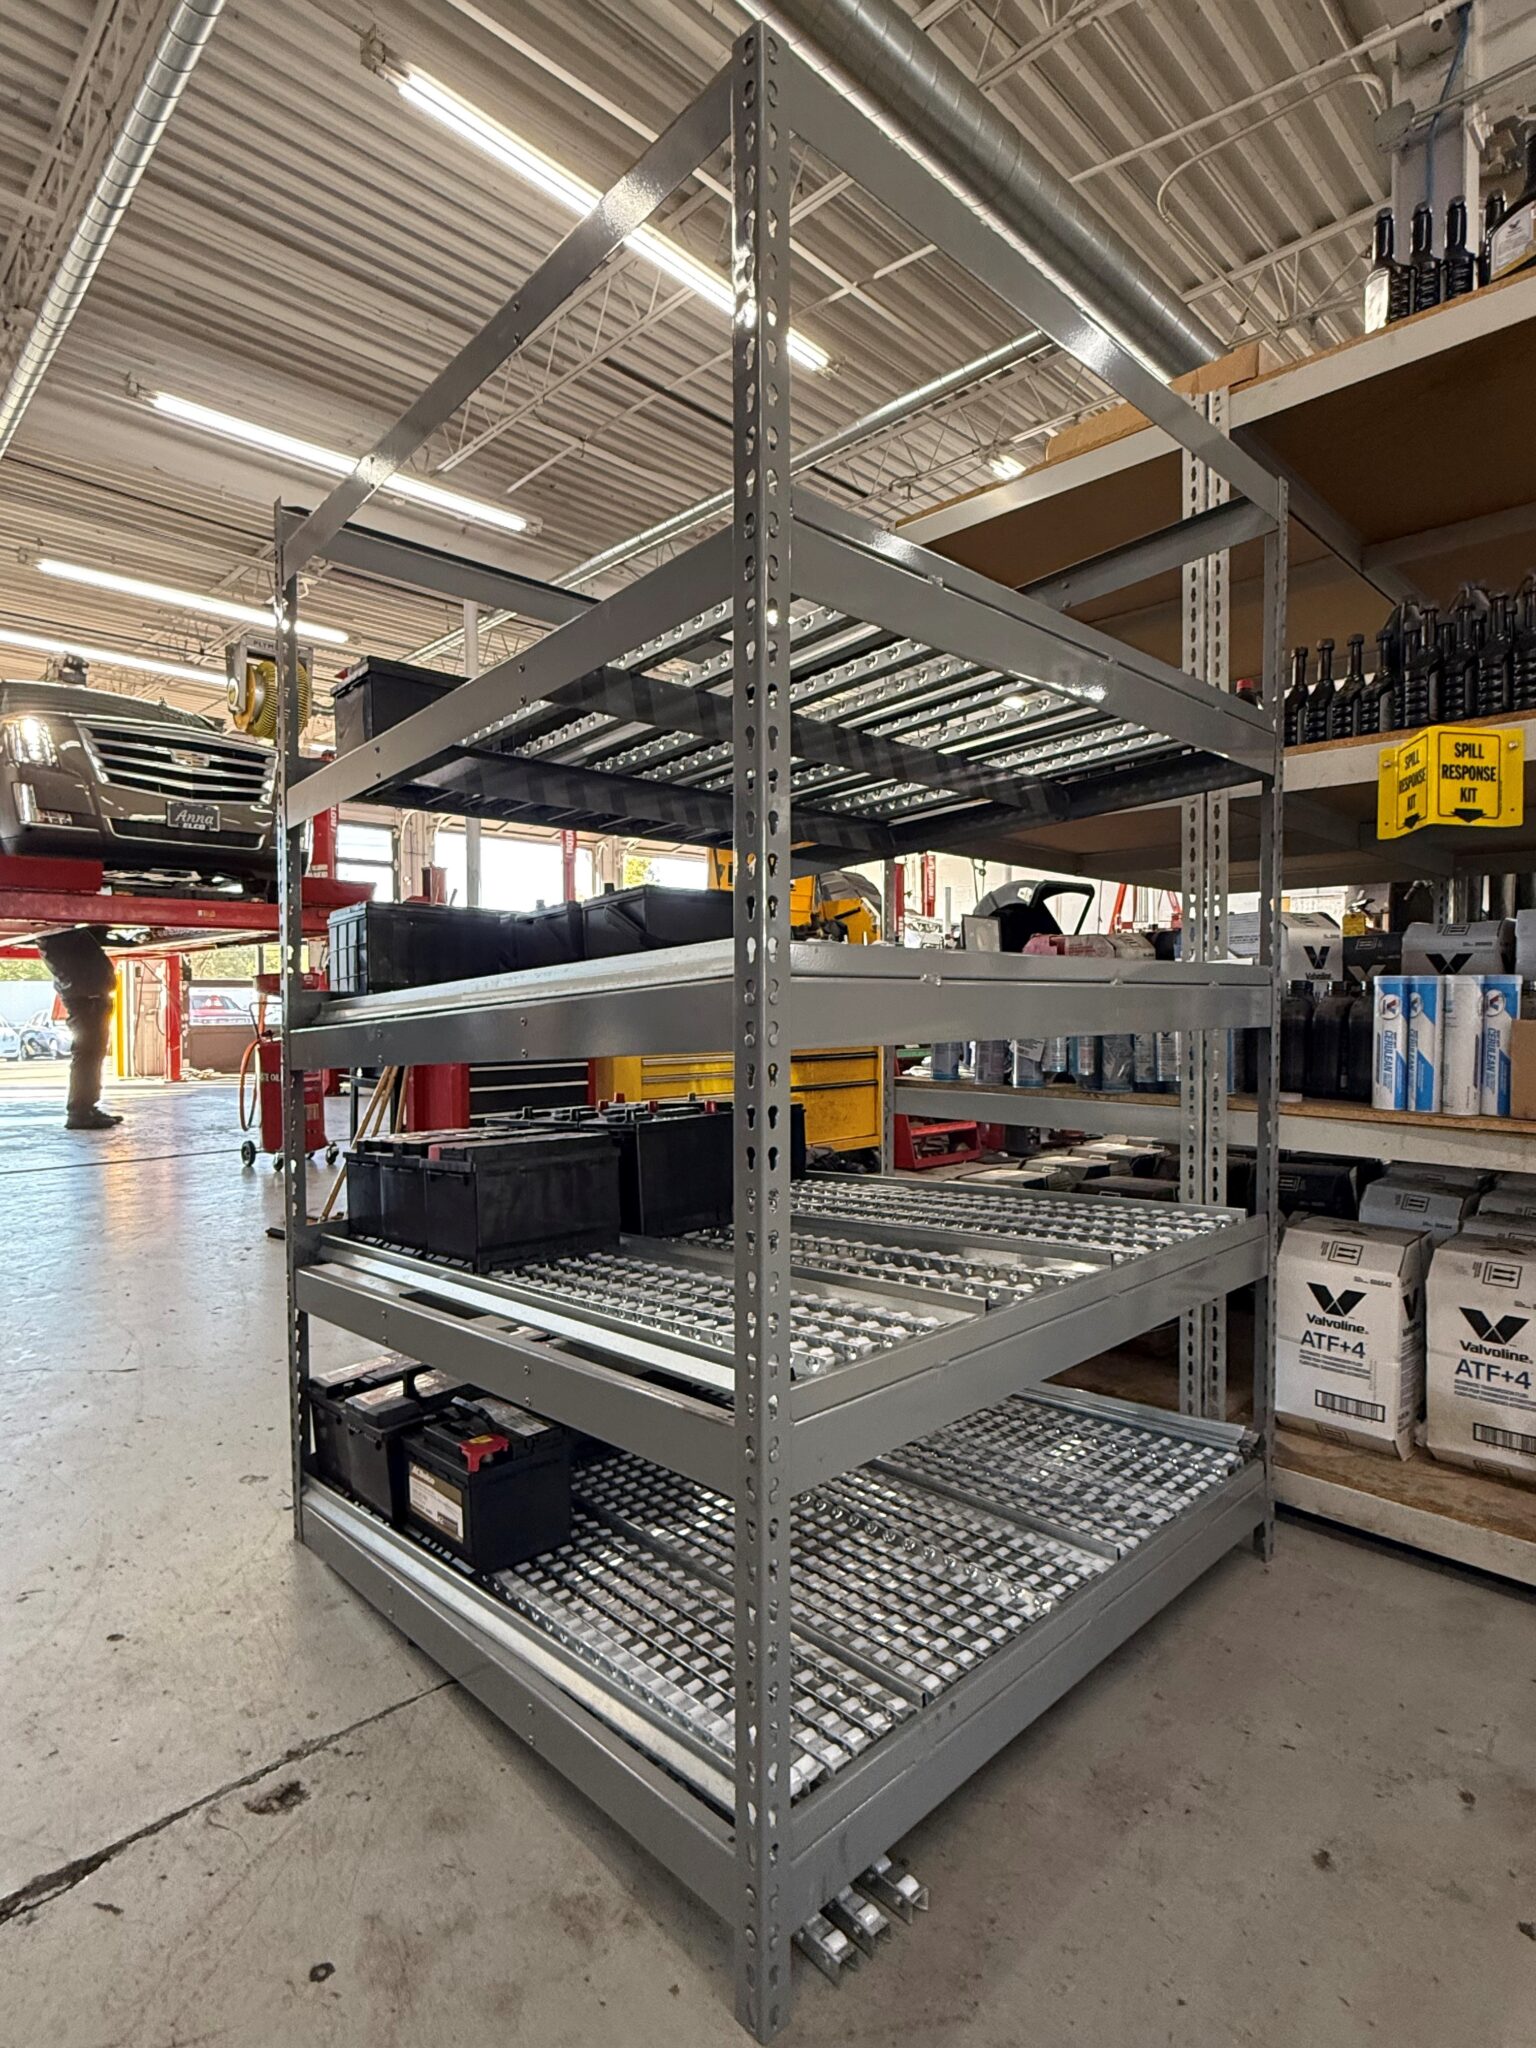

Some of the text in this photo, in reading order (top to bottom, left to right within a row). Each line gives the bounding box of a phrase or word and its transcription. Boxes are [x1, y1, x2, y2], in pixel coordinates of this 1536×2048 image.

[1404, 749, 1420, 770] SPILL
[1454, 742, 1485, 759] SPILL
[1441, 764, 1497, 782] RESPONSE
[1460, 787, 1478, 803] KIT
[175, 809, 214, 826] Anna
[1383, 1030, 1394, 1073] CERULEAN
[1487, 1028, 1497, 1072] CERULEAN
[1306, 1312, 1366, 1335] Valvoline
[1300, 1329, 1366, 1359] ATF+4
[1459, 1339, 1530, 1364] Valvoline
[1455, 1358, 1532, 1390] ATF+4
